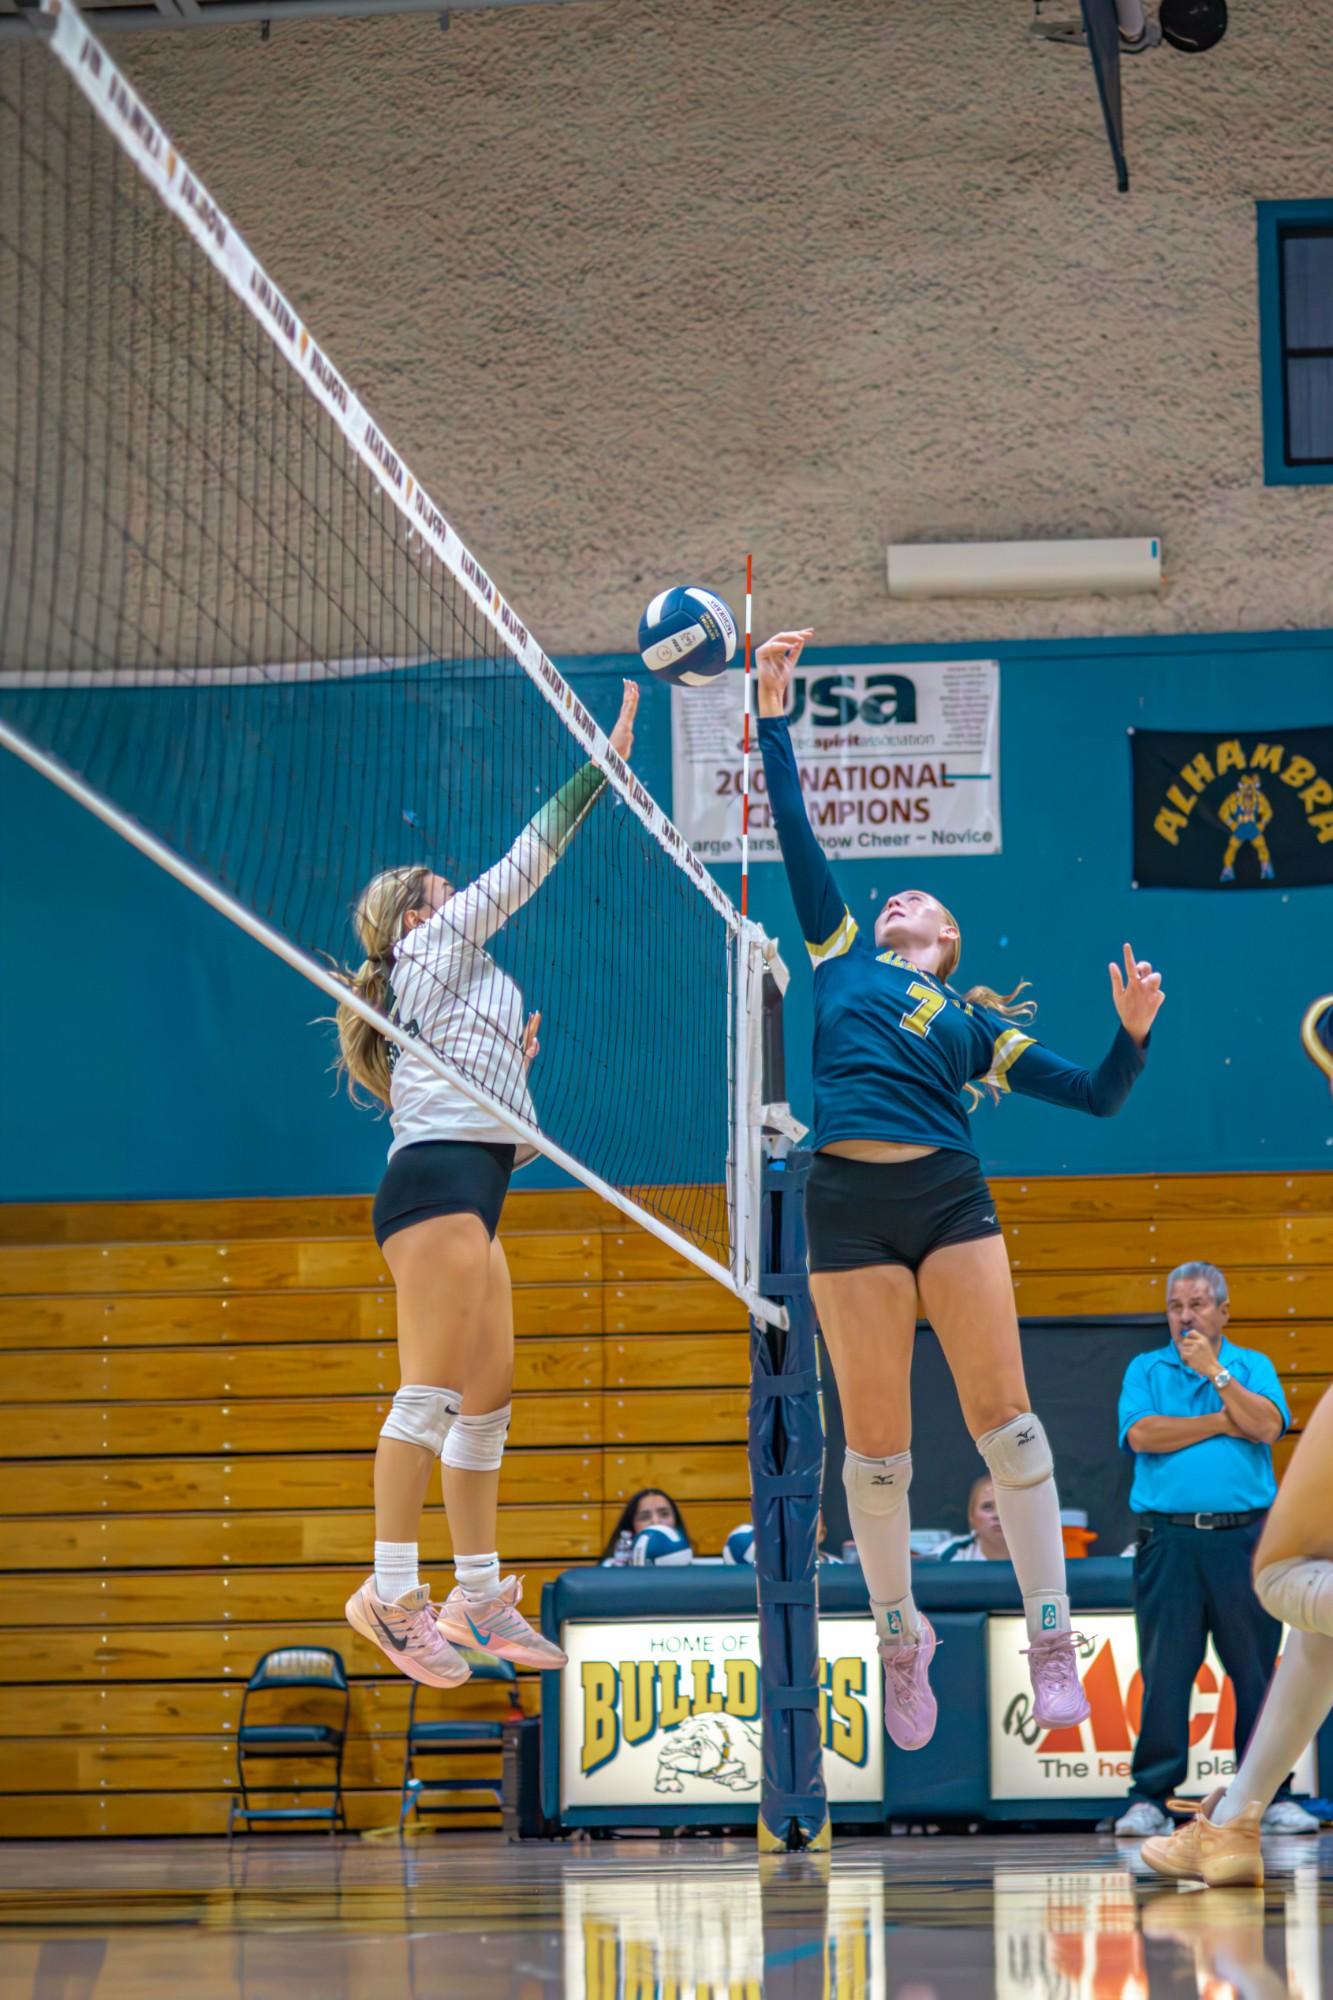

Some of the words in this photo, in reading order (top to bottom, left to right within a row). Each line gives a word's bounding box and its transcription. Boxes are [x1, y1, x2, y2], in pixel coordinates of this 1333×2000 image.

[716, 768, 768, 796] 200
[800, 762, 956, 794] NATIONAL
[692, 840, 733, 857] arge
[816, 834, 853, 848] how
[857, 832, 911, 848] Cheer
[931, 829, 993, 845] Novice
[900, 981, 947, 1038] 7
[650, 1636, 715, 1653] HOME
[722, 1635, 751, 1652] OF
[580, 1656, 868, 1777] BULLDS
[1038, 1759, 1089, 1778] The
[1197, 1757, 1238, 1780] pla
